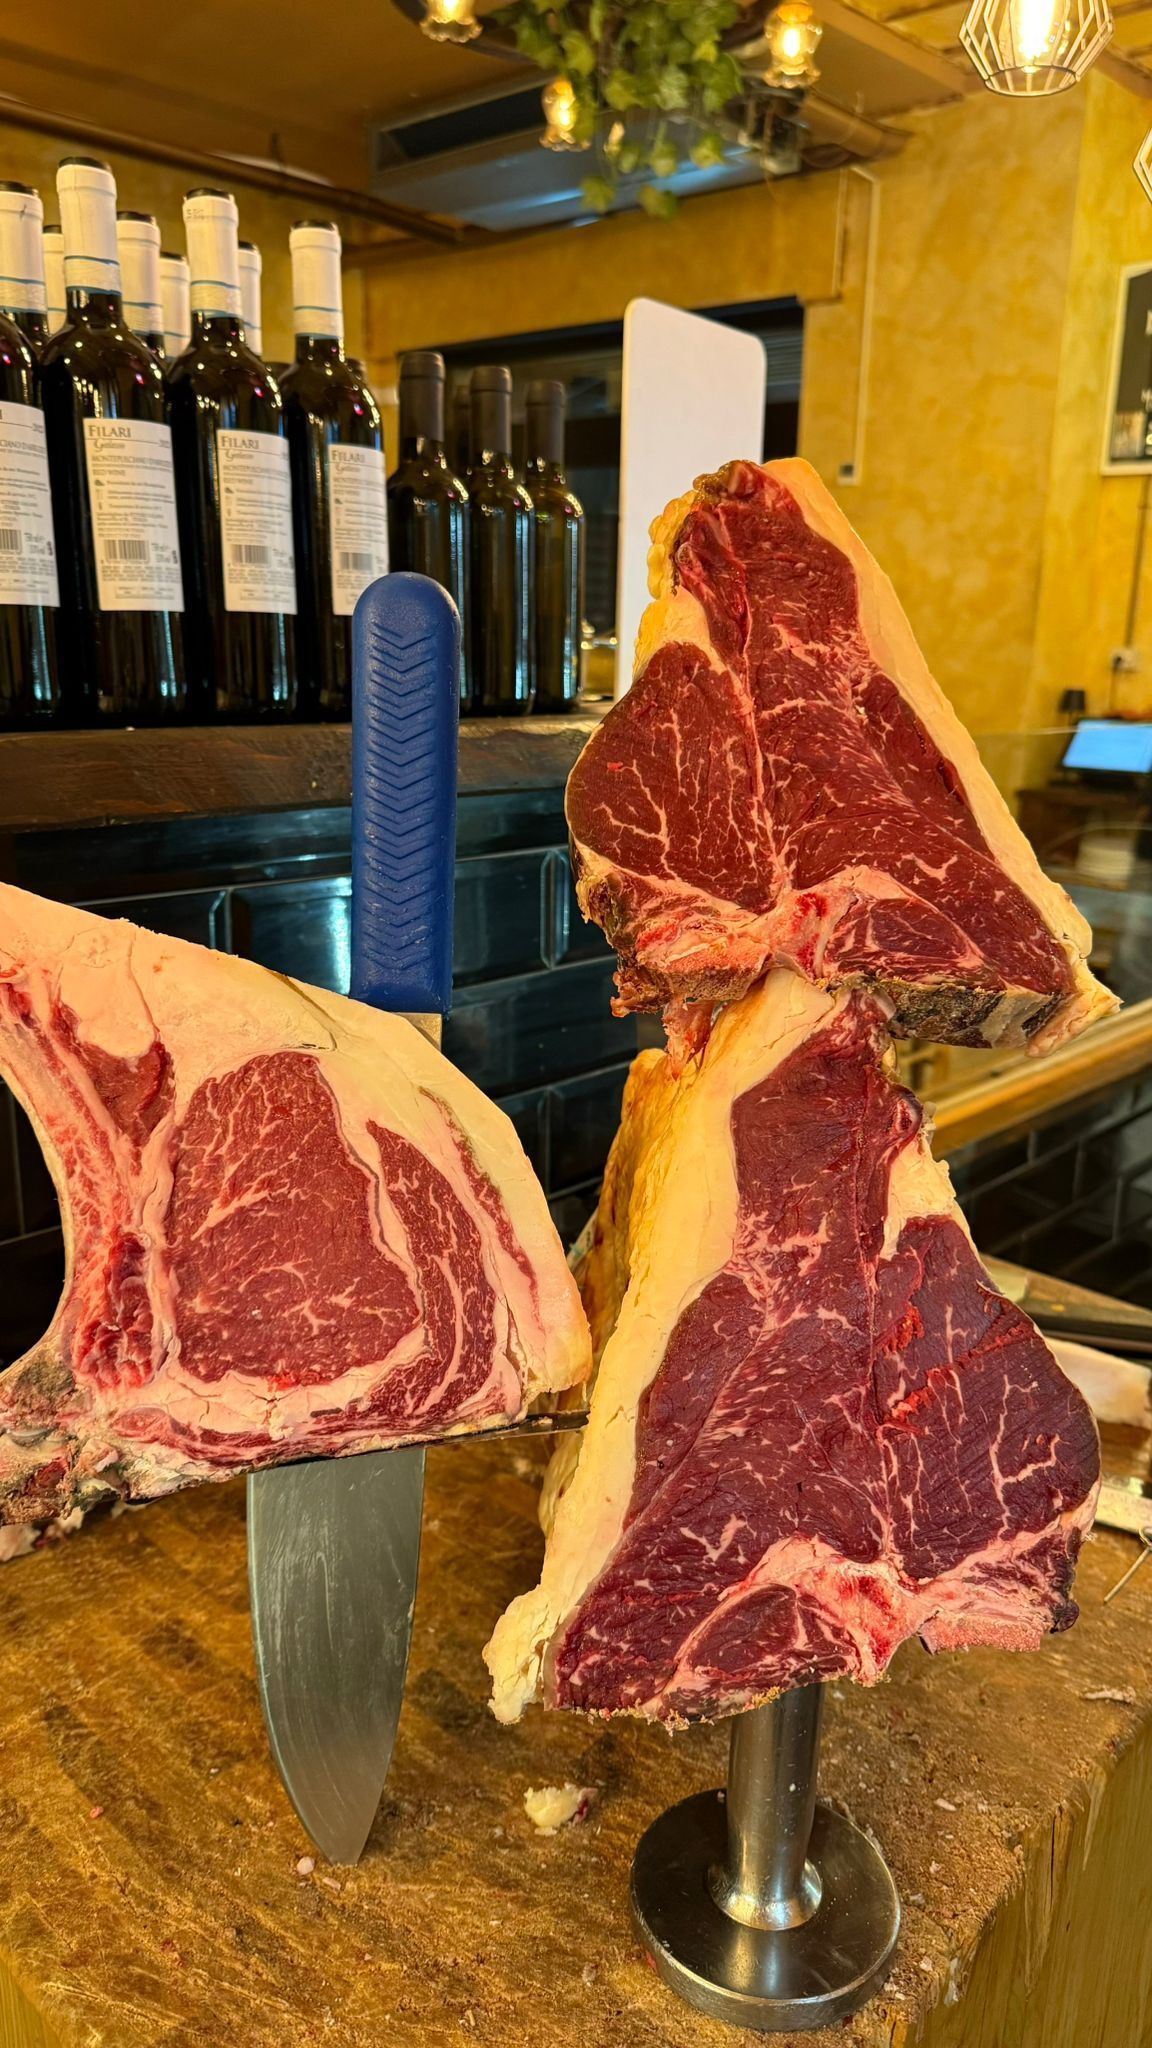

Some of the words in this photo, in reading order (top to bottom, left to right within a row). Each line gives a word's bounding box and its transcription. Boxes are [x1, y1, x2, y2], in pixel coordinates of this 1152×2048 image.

[88, 425, 131, 438] FILARI
[221, 436, 259, 450] FILARI
[331, 450, 365, 463] FILARI
